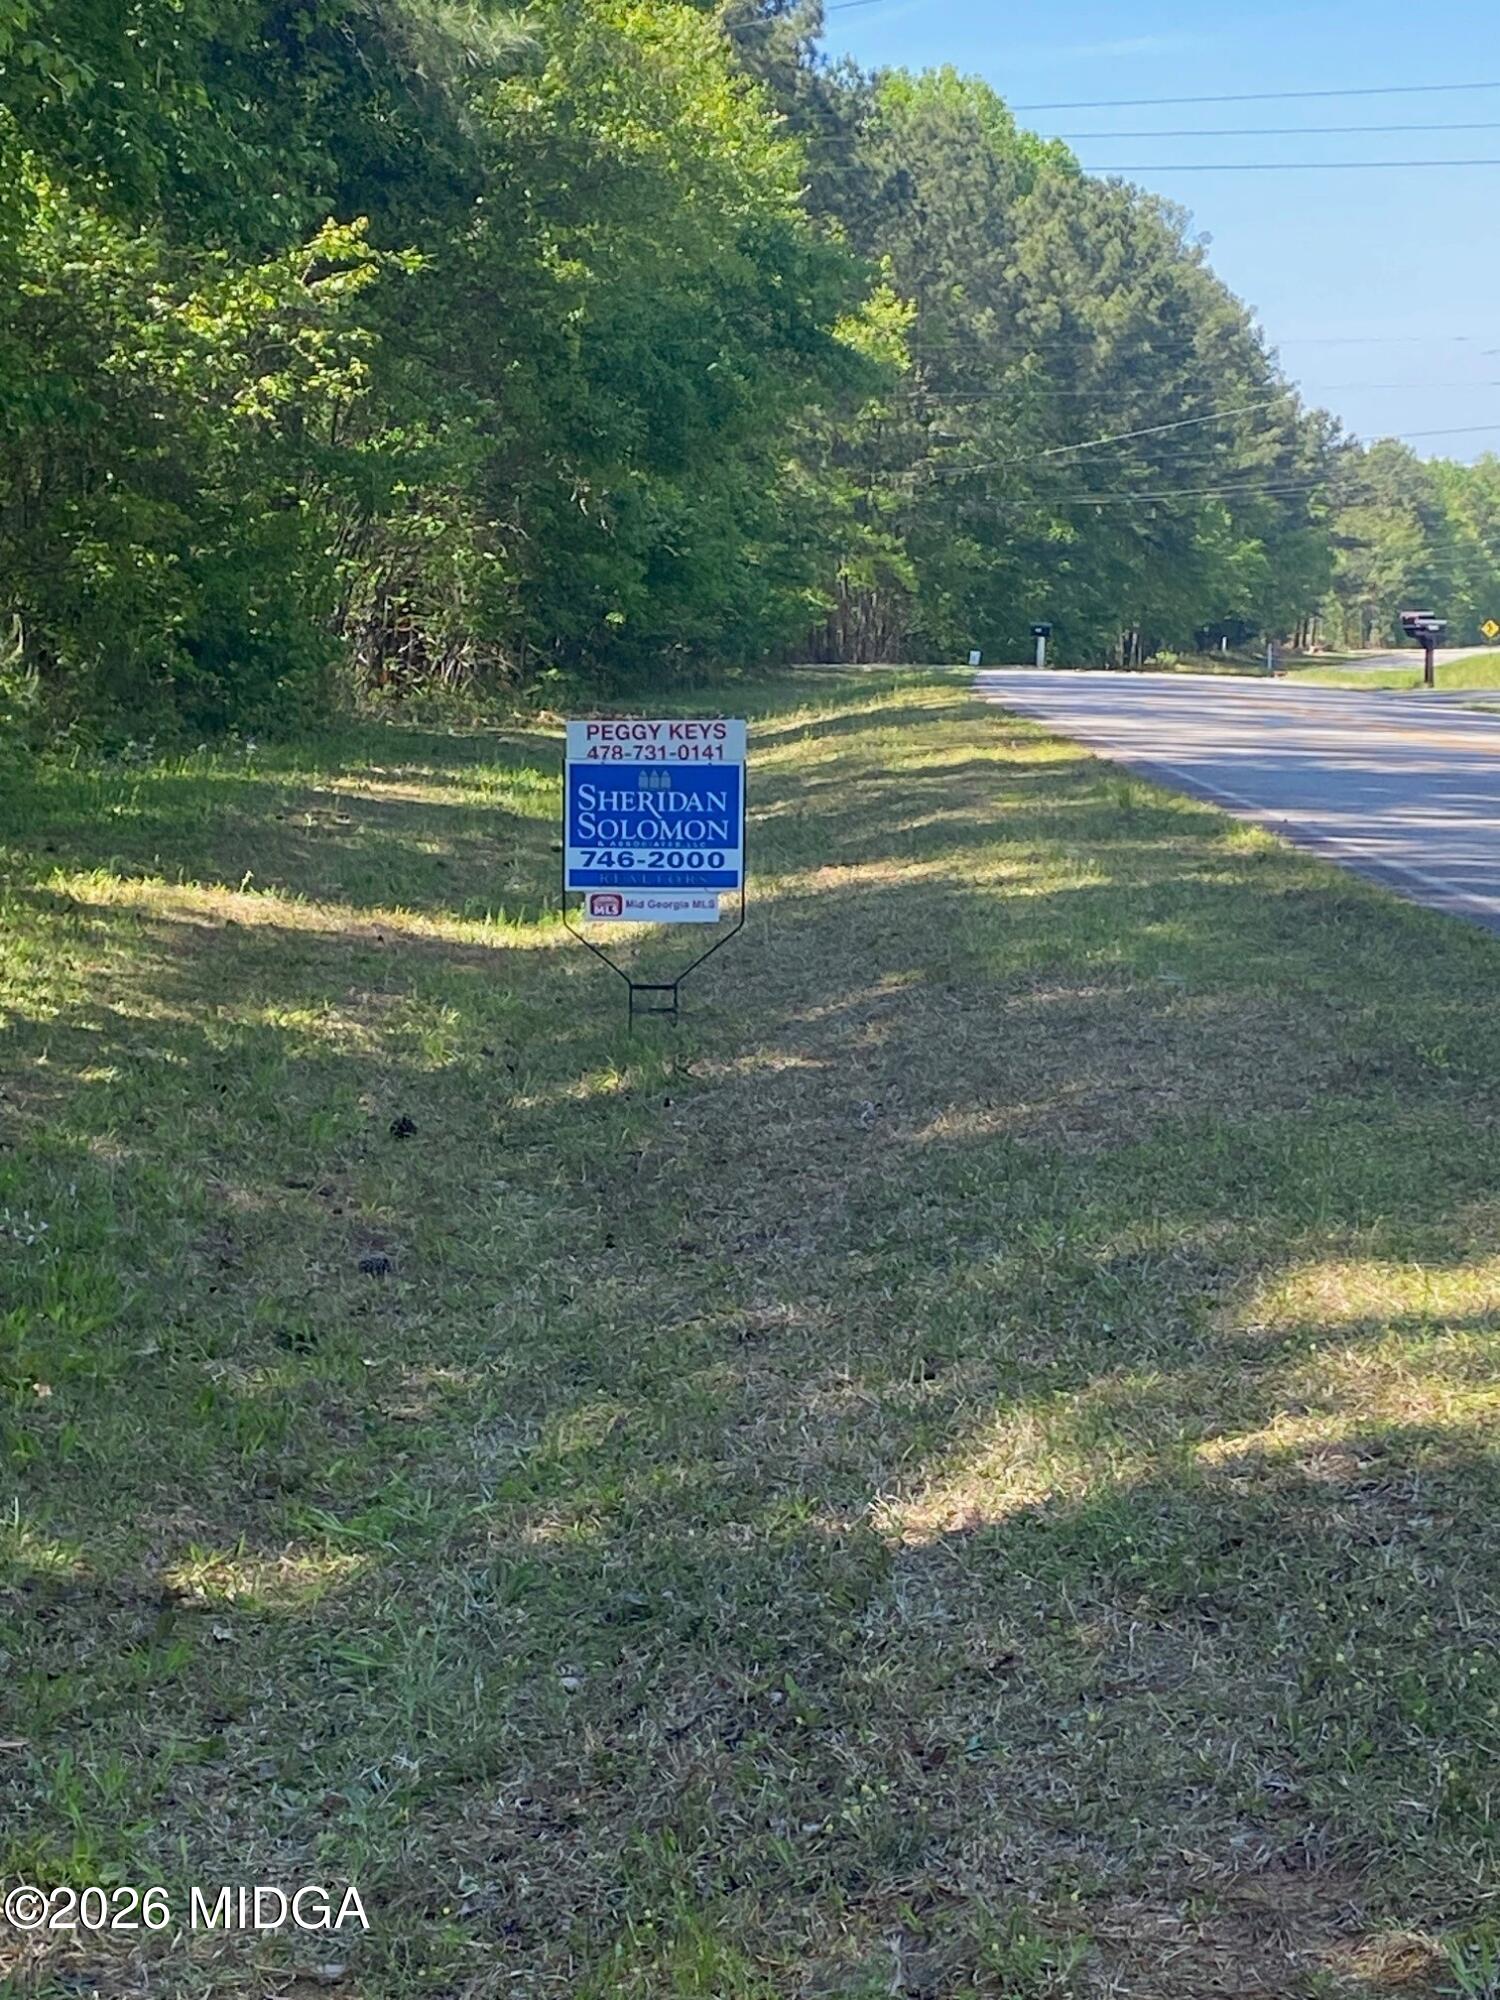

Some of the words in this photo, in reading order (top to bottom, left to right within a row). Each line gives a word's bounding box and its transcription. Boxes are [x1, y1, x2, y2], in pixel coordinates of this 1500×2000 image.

[586, 724, 663, 741] PEGGY
[669, 723, 727, 740] KEYS
[587, 744, 724, 761] 478-731-0141
[577, 783, 728, 819] SHERIDAN
[577, 812, 729, 841] SOLOMON
[580, 851, 725, 869] 746-2000
[593, 905, 619, 915] MLS
[625, 899, 645, 909] Mid
[647, 899, 689, 911] Georgia
[692, 899, 715, 909] MLS
